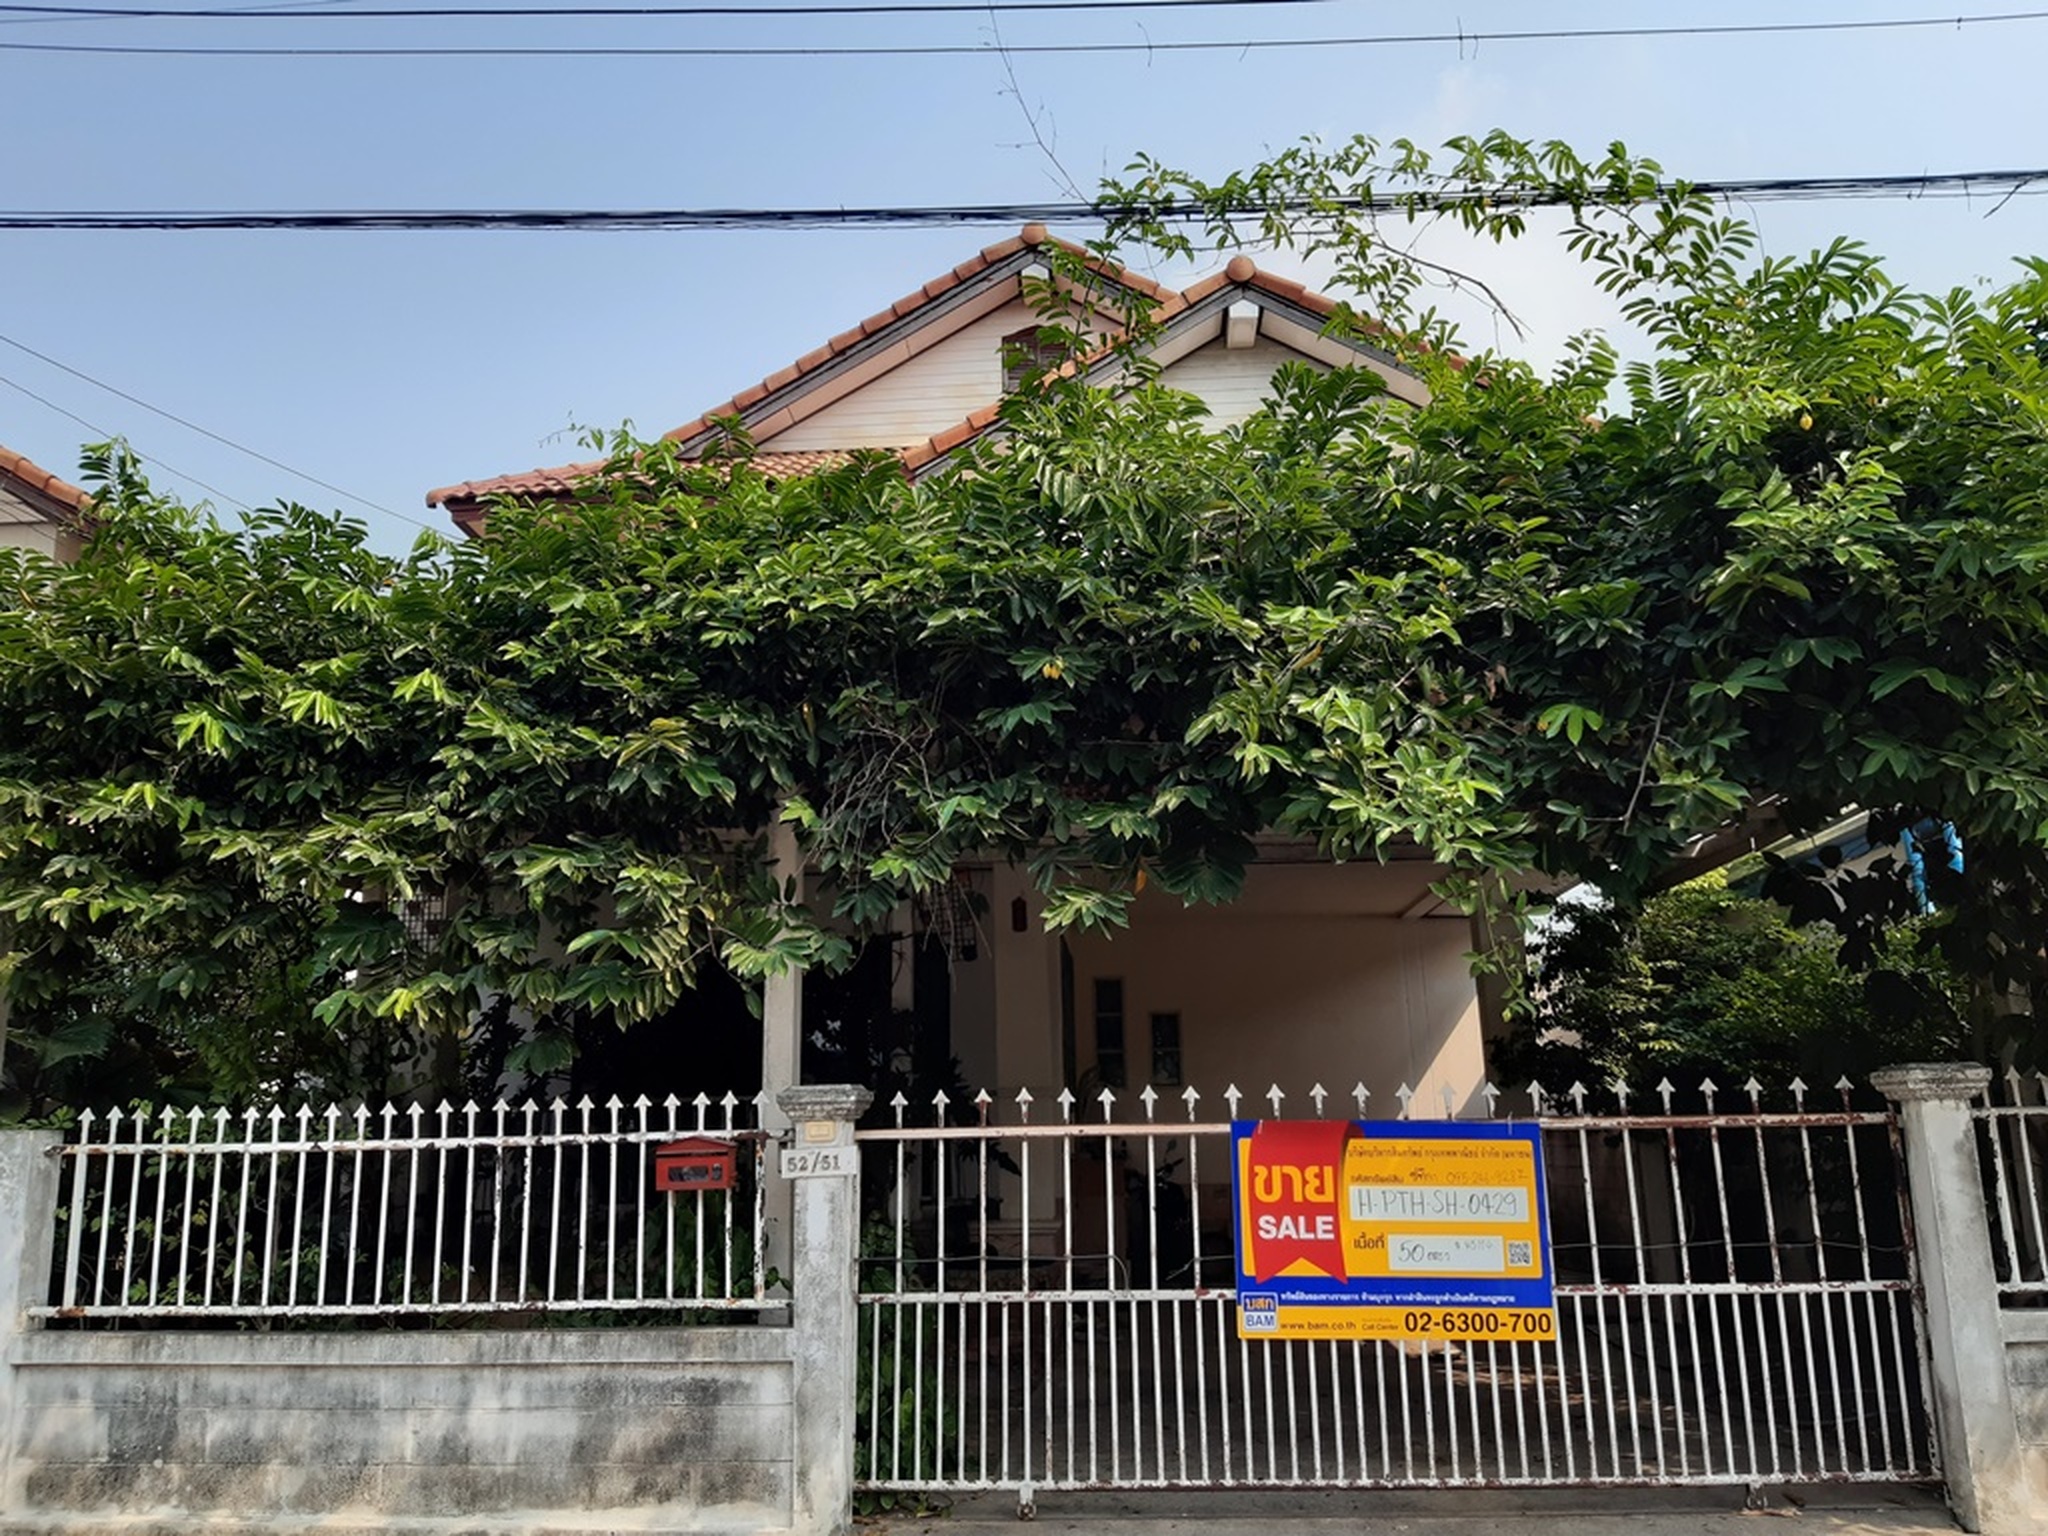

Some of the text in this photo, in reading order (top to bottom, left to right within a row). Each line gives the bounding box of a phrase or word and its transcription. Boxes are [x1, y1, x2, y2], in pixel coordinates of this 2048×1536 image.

[788, 1151, 840, 1173] 52/51
[1254, 1165, 1334, 1203] ขาย
[1258, 1215, 1335, 1240] SALE
[1398, 1240, 1425, 1263] 50
[1246, 1314, 1274, 1326] BAM
[1280, 1320, 1357, 1331] www.bam.co.th
[1405, 1312, 1551, 1333] 02-6300-700
